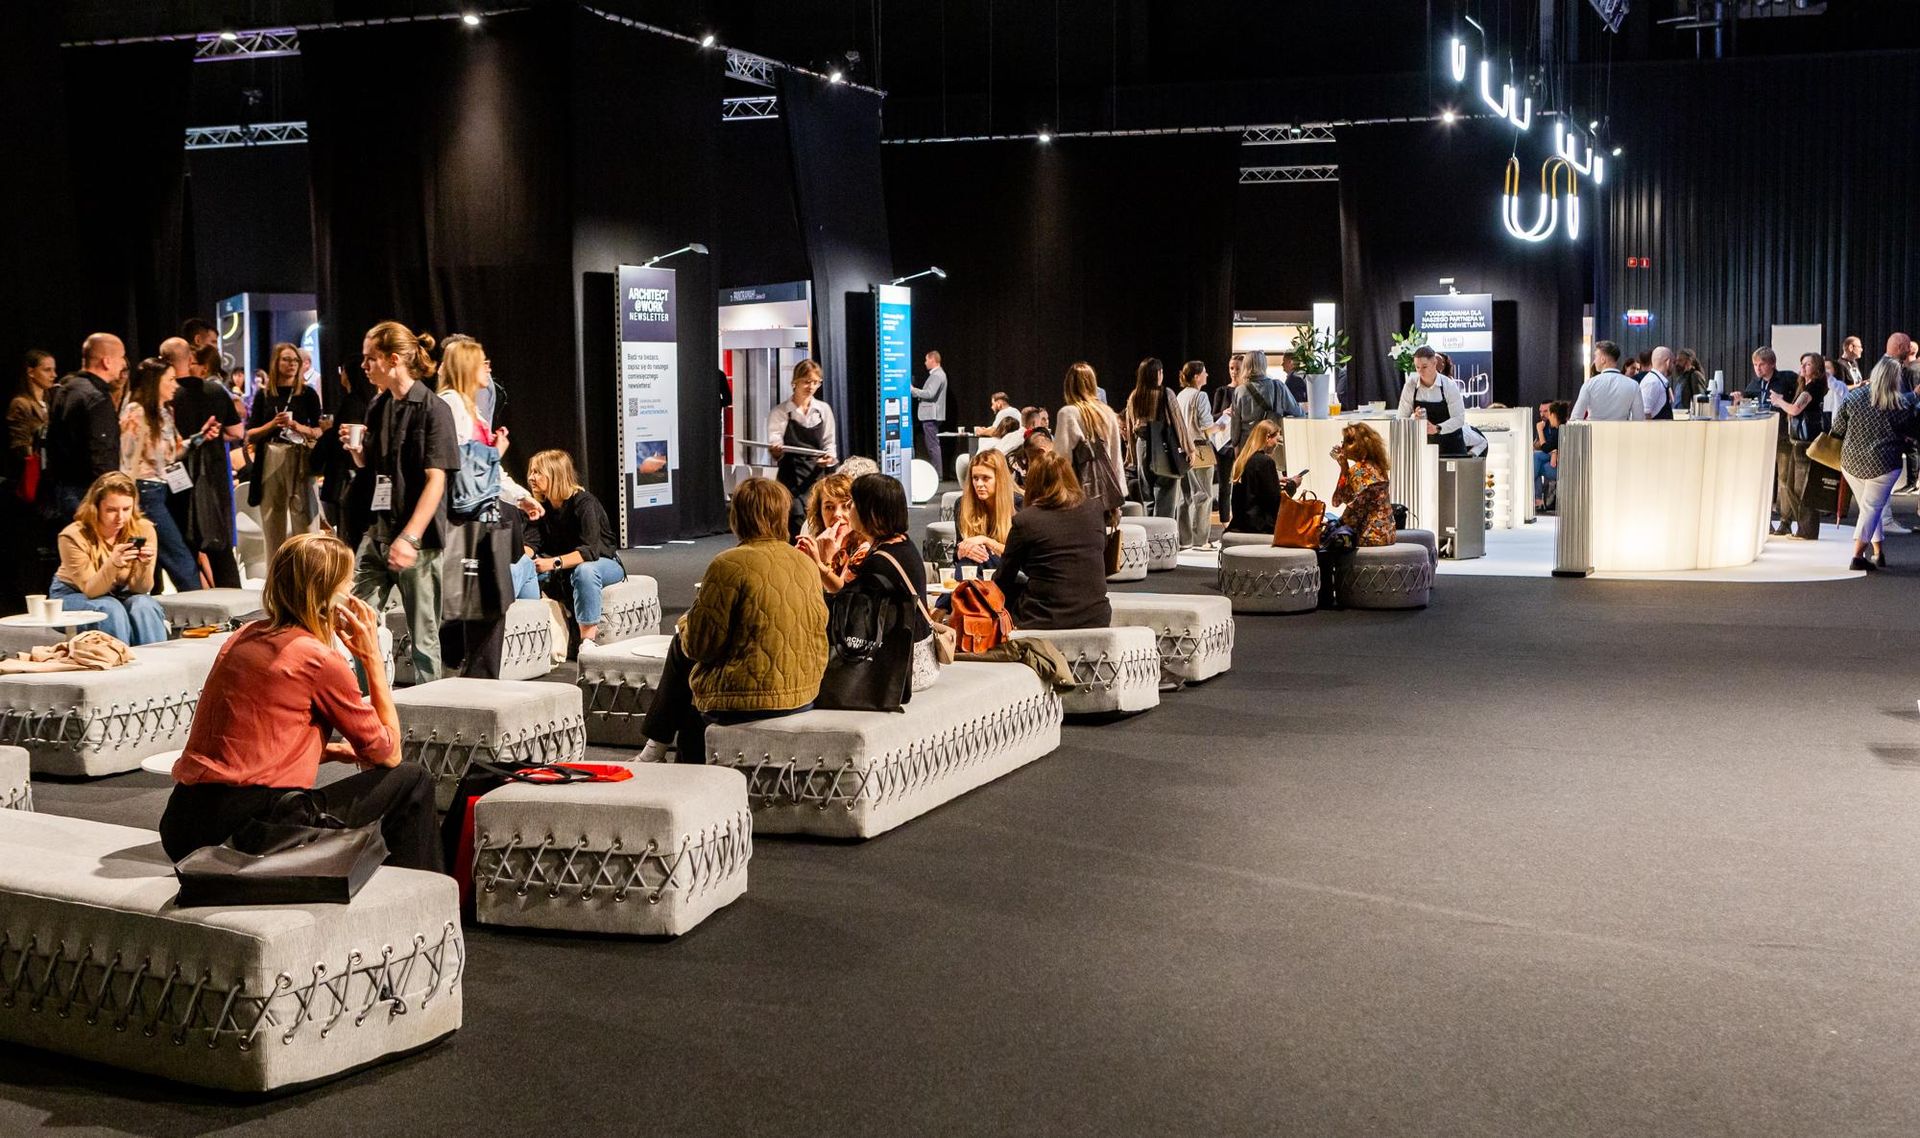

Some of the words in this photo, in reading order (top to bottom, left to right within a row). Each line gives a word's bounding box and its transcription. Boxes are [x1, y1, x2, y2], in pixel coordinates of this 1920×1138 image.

[628, 288, 669, 301] ARCHITECT
[635, 300, 664, 312] @WORK
[629, 312, 669, 322] NEWSLETTER
